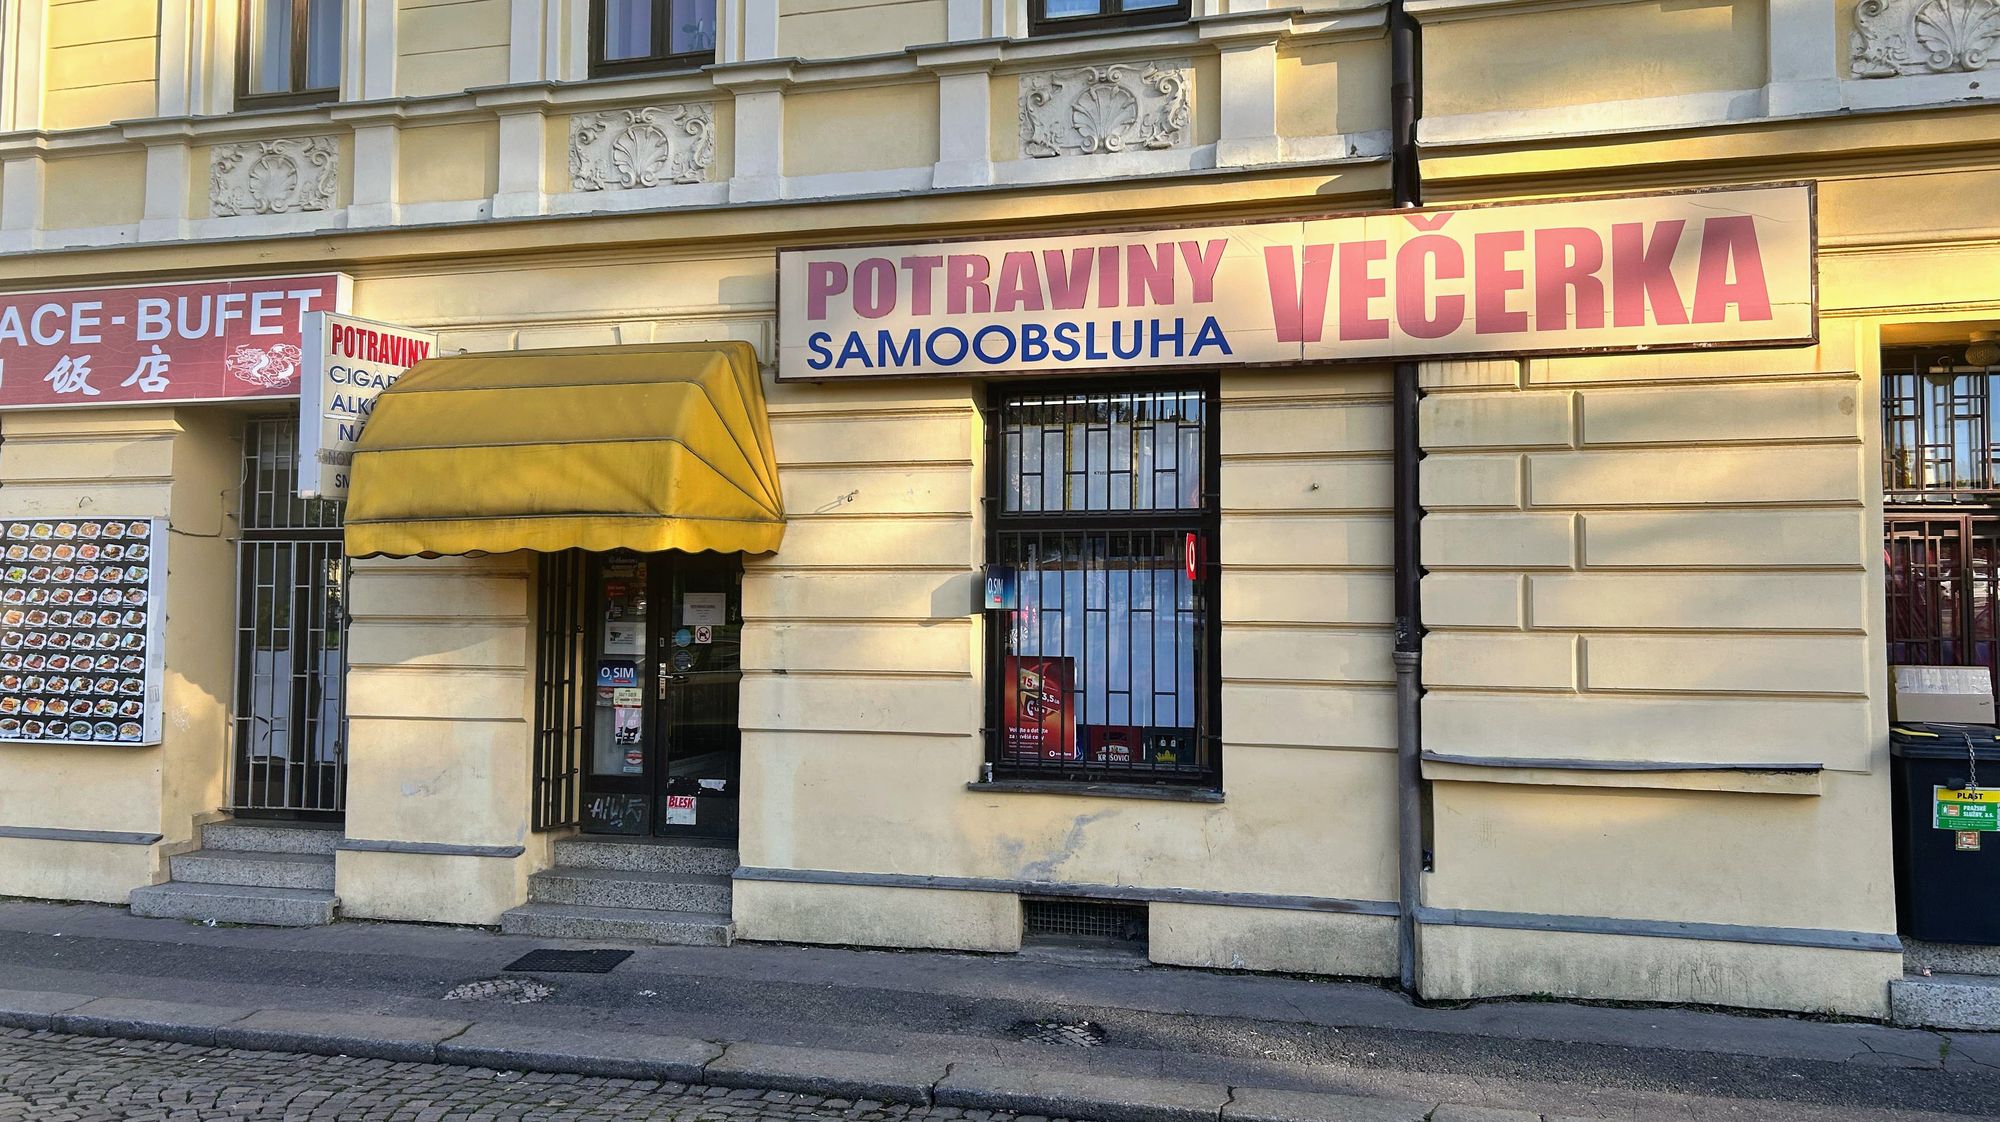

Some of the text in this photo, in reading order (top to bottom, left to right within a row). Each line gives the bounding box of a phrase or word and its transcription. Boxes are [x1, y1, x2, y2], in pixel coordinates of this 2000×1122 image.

[807, 238, 1228, 321] POTRAVINY
[1264, 213, 1773, 343] VEČERKA
[331, 323, 430, 369] POTRAVINY
[807, 316, 1233, 370] SAMOOBSLUHA
[614, 667, 634, 678] SIM
[669, 796, 694, 808] BLESK
